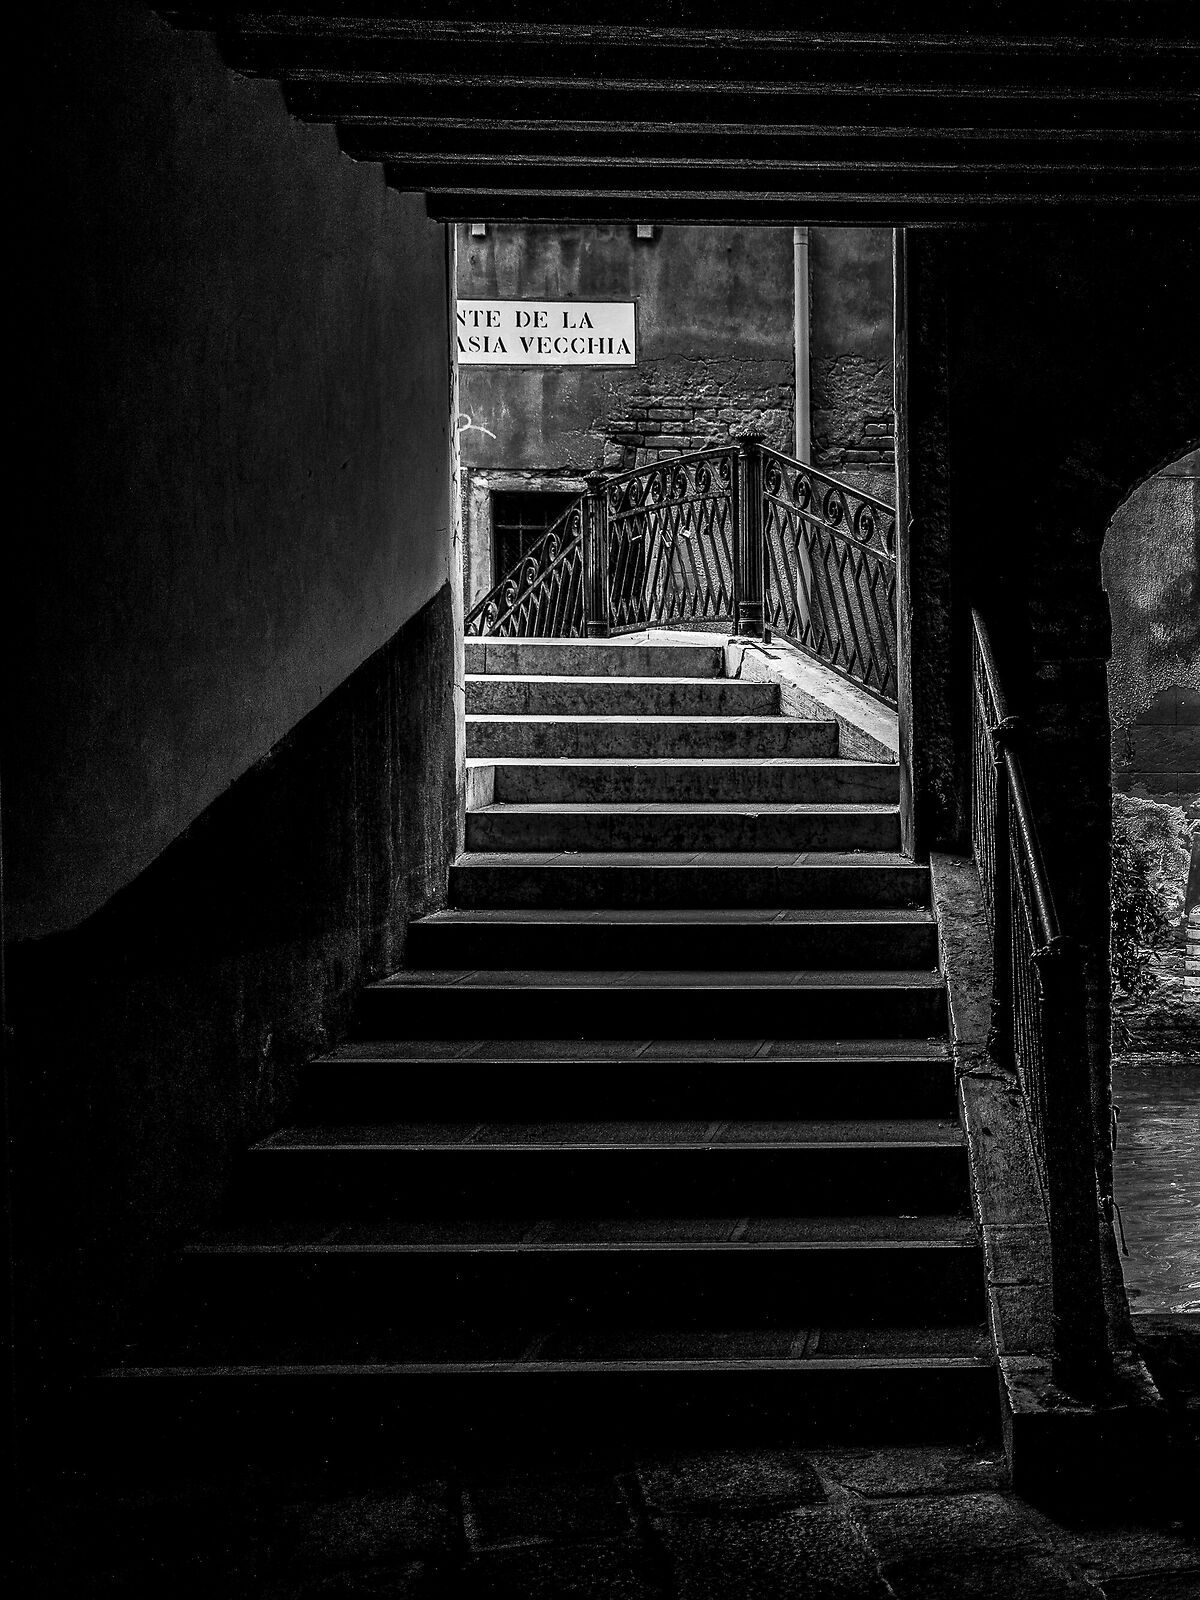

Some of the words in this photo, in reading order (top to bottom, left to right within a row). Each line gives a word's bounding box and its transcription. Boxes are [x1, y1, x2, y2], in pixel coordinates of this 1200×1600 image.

[515, 311, 548, 328] DE
[562, 311, 594, 329] LA
[519, 336, 632, 355] VECCHIA
